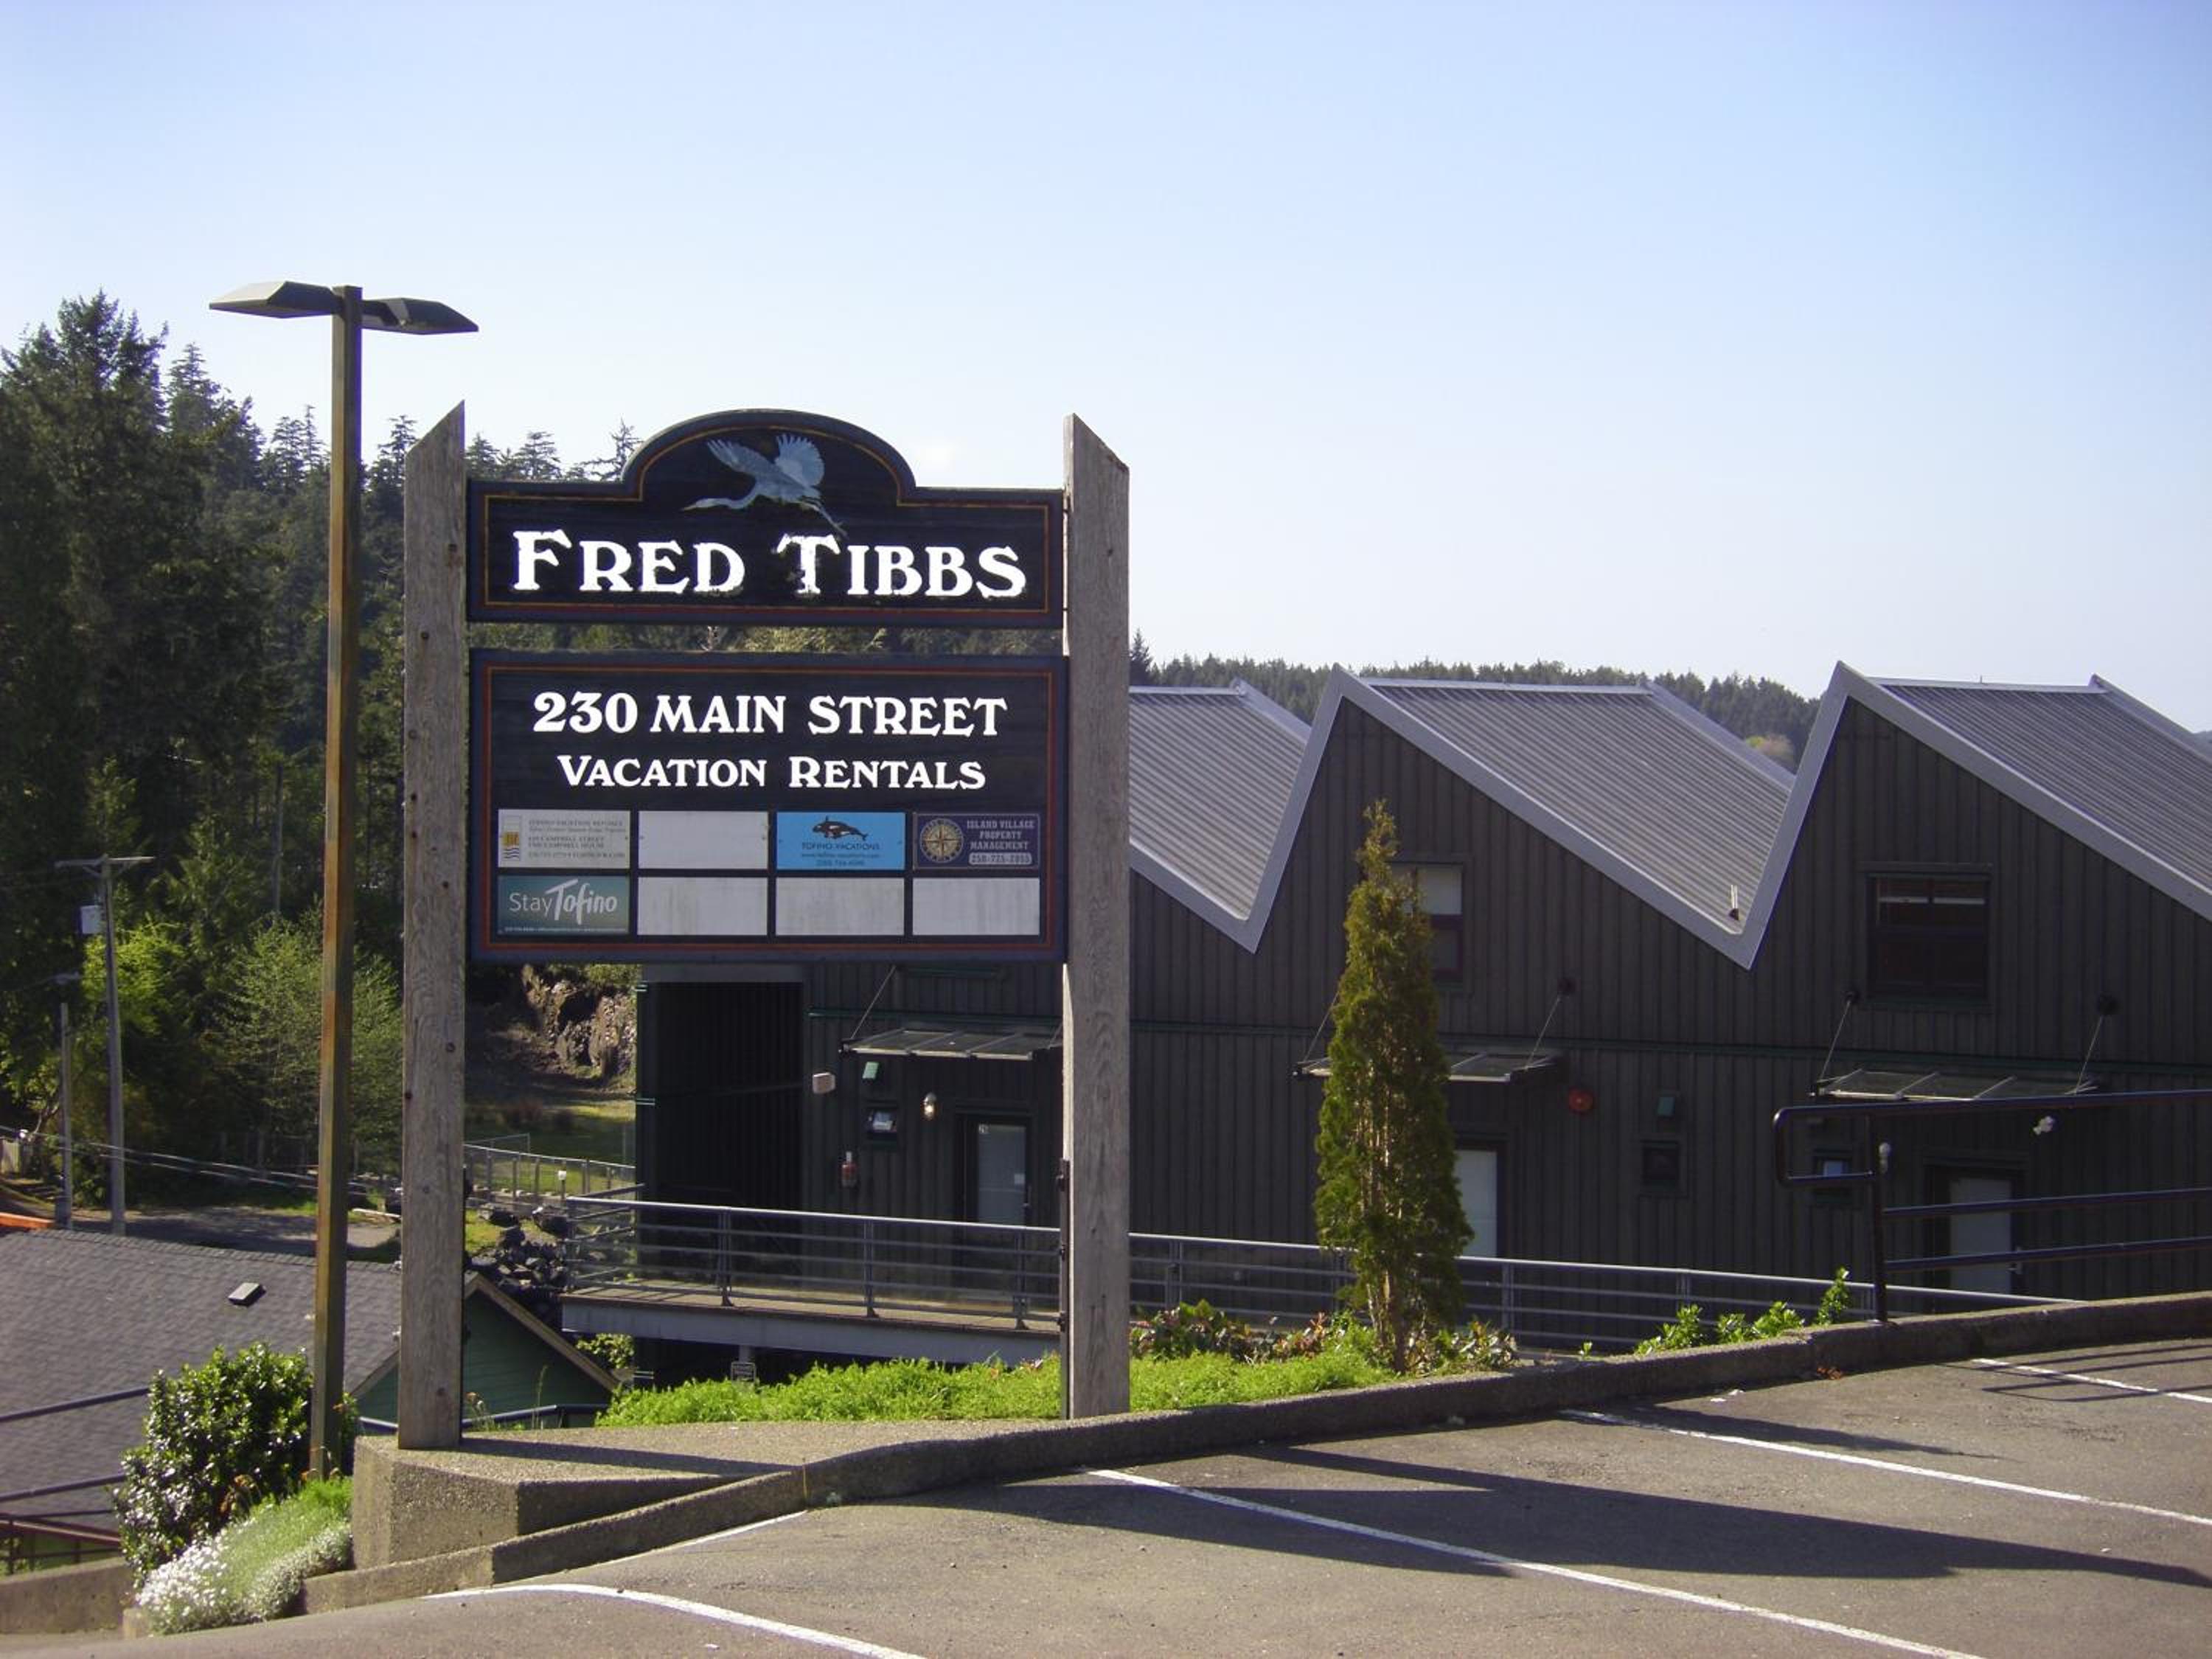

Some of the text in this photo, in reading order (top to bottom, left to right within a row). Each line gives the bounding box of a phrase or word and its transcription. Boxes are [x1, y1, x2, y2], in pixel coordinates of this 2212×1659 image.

[533, 691, 1008, 737] 230 MAIN STREET
[557, 754, 986, 790] VACATION RENTALS
[967, 819, 1035, 829] ISLAND VILLAGE
[979, 830, 1023, 840] PROPERTY
[970, 841, 1029, 850] MANAGEMENT
